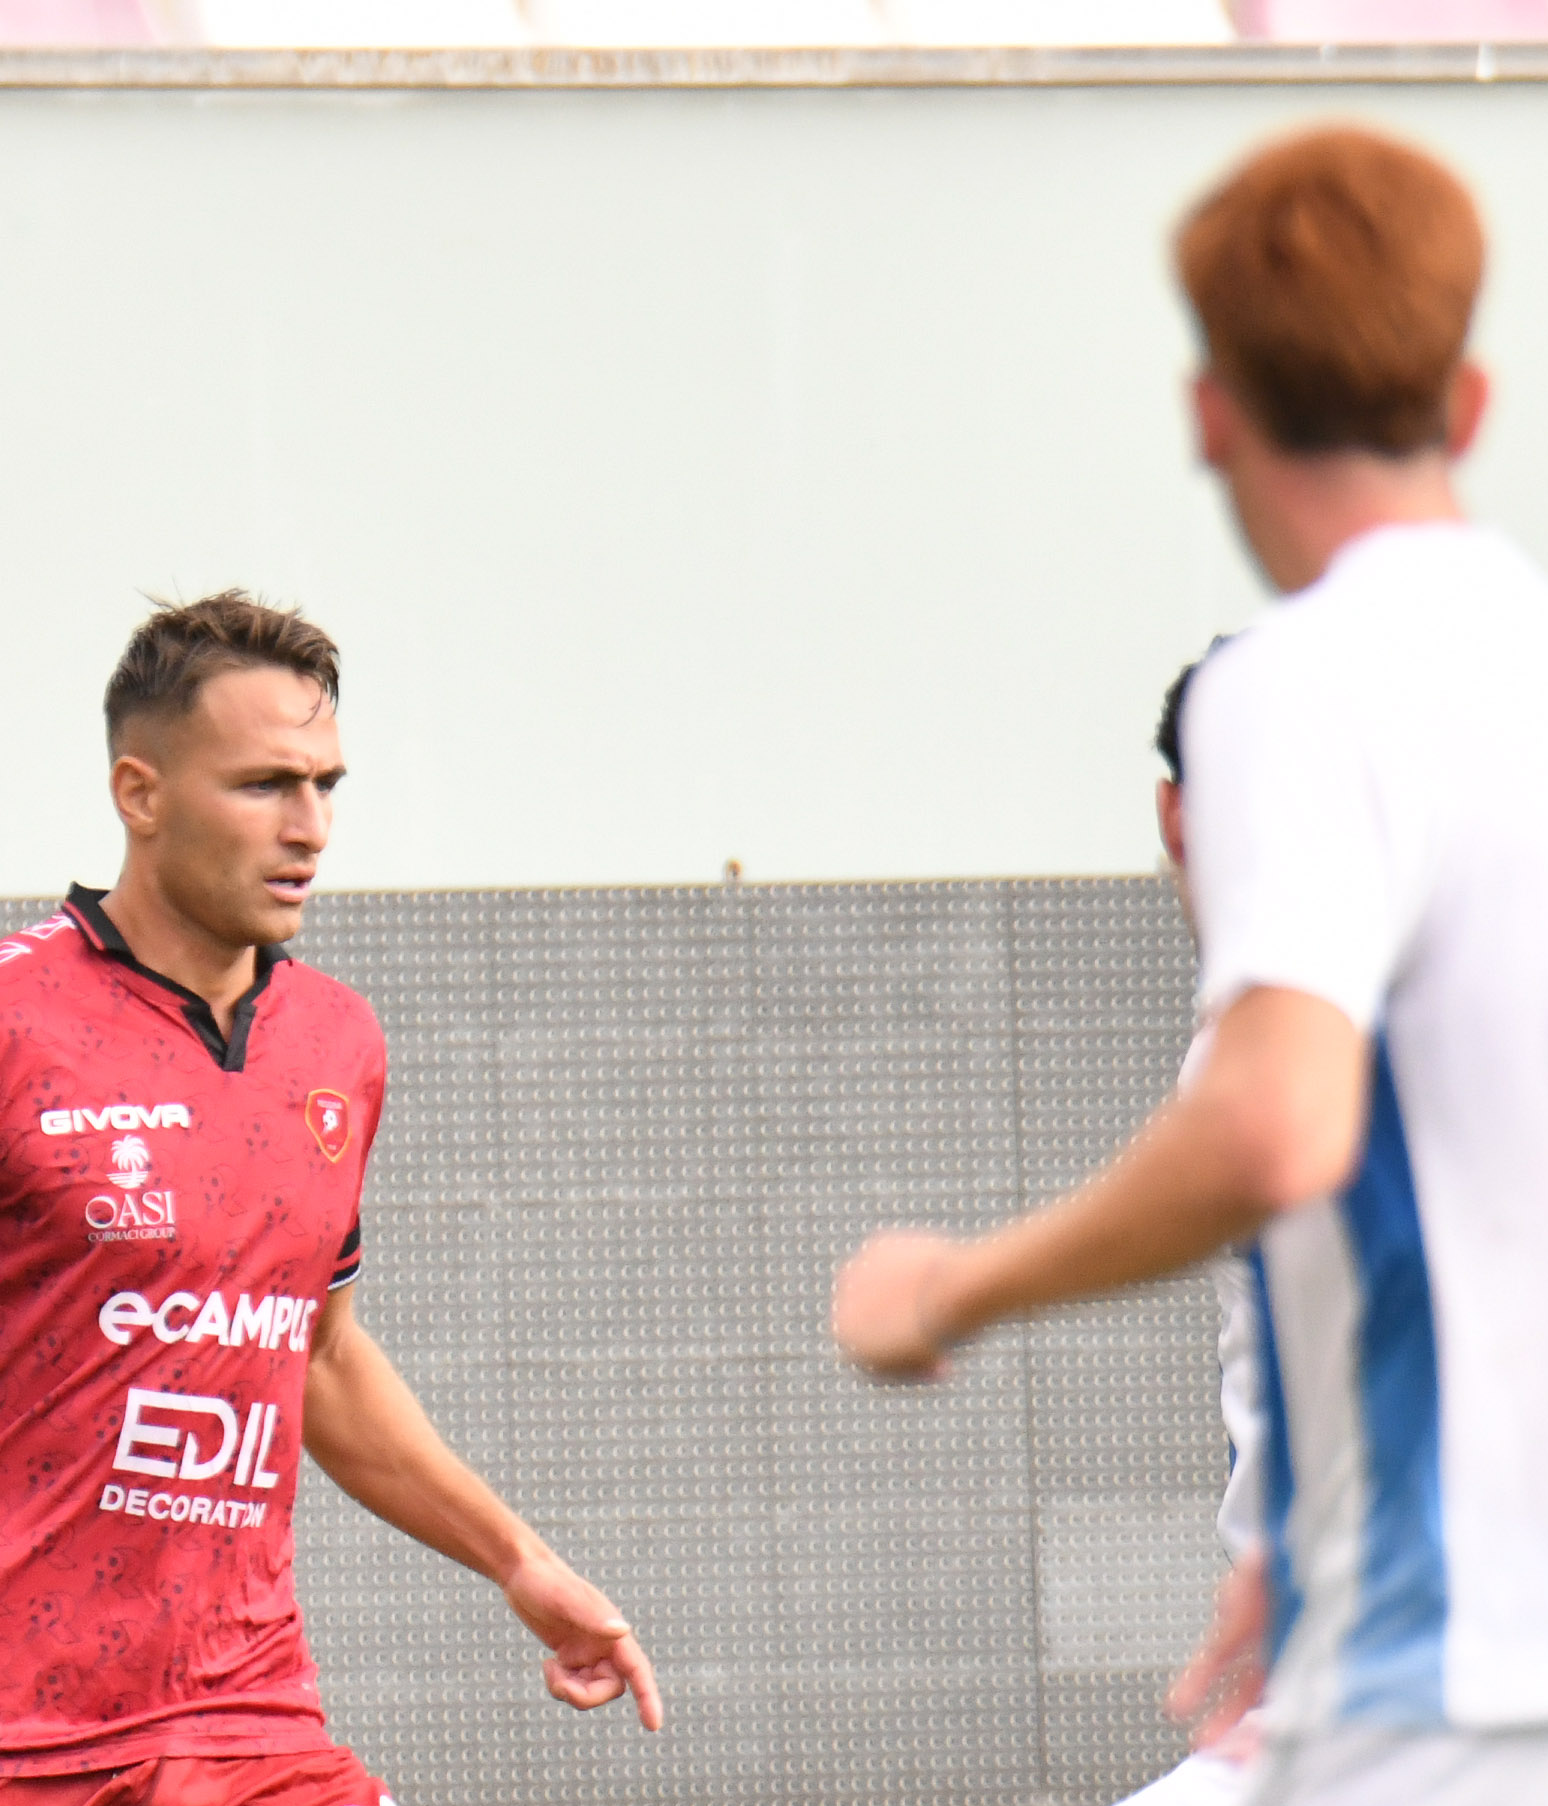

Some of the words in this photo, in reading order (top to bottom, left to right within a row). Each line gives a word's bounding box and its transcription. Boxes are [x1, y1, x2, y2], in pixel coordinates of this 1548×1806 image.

[40, 1104, 190, 1136] GIVOVA
[85, 1190, 176, 1229] OASI
[112, 1387, 280, 1488] EDIL
